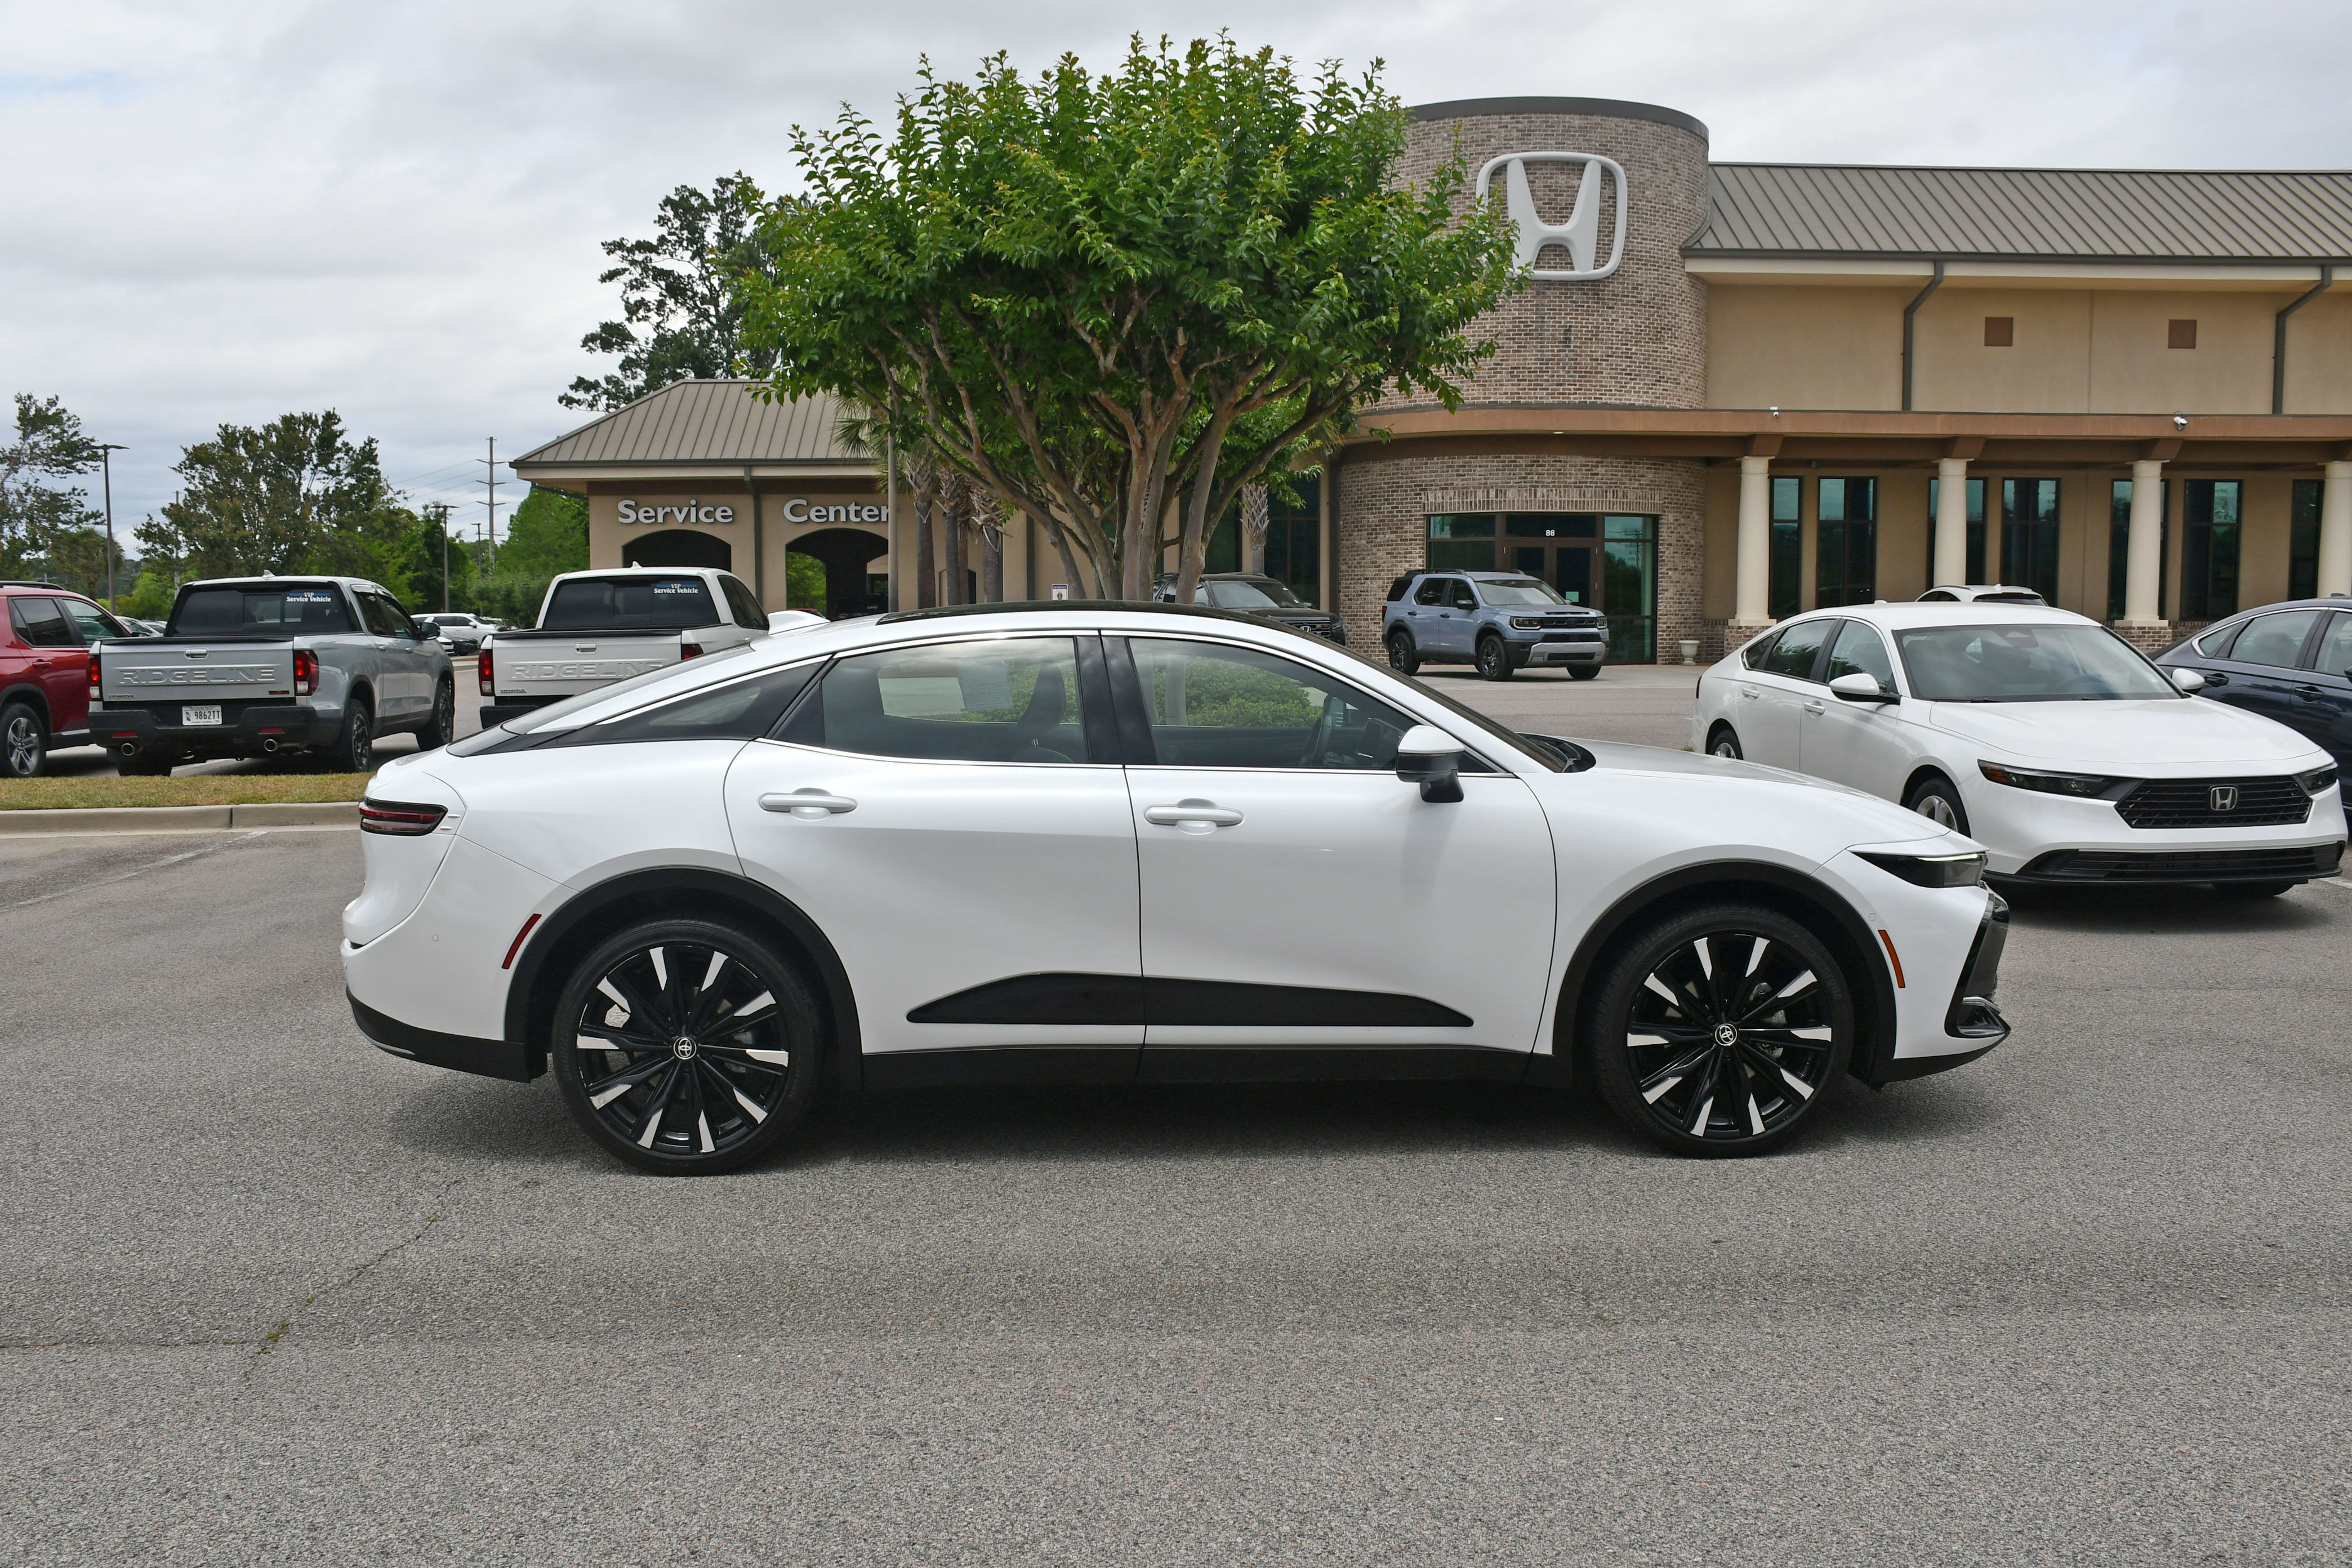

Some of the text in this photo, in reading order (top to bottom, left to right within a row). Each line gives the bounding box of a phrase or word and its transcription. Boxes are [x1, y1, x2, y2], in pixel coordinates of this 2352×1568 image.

[618, 498, 889, 523] Service Center
[119, 667, 275, 684] RIDGELINE
[194, 711, 220, 720] 9862TT
